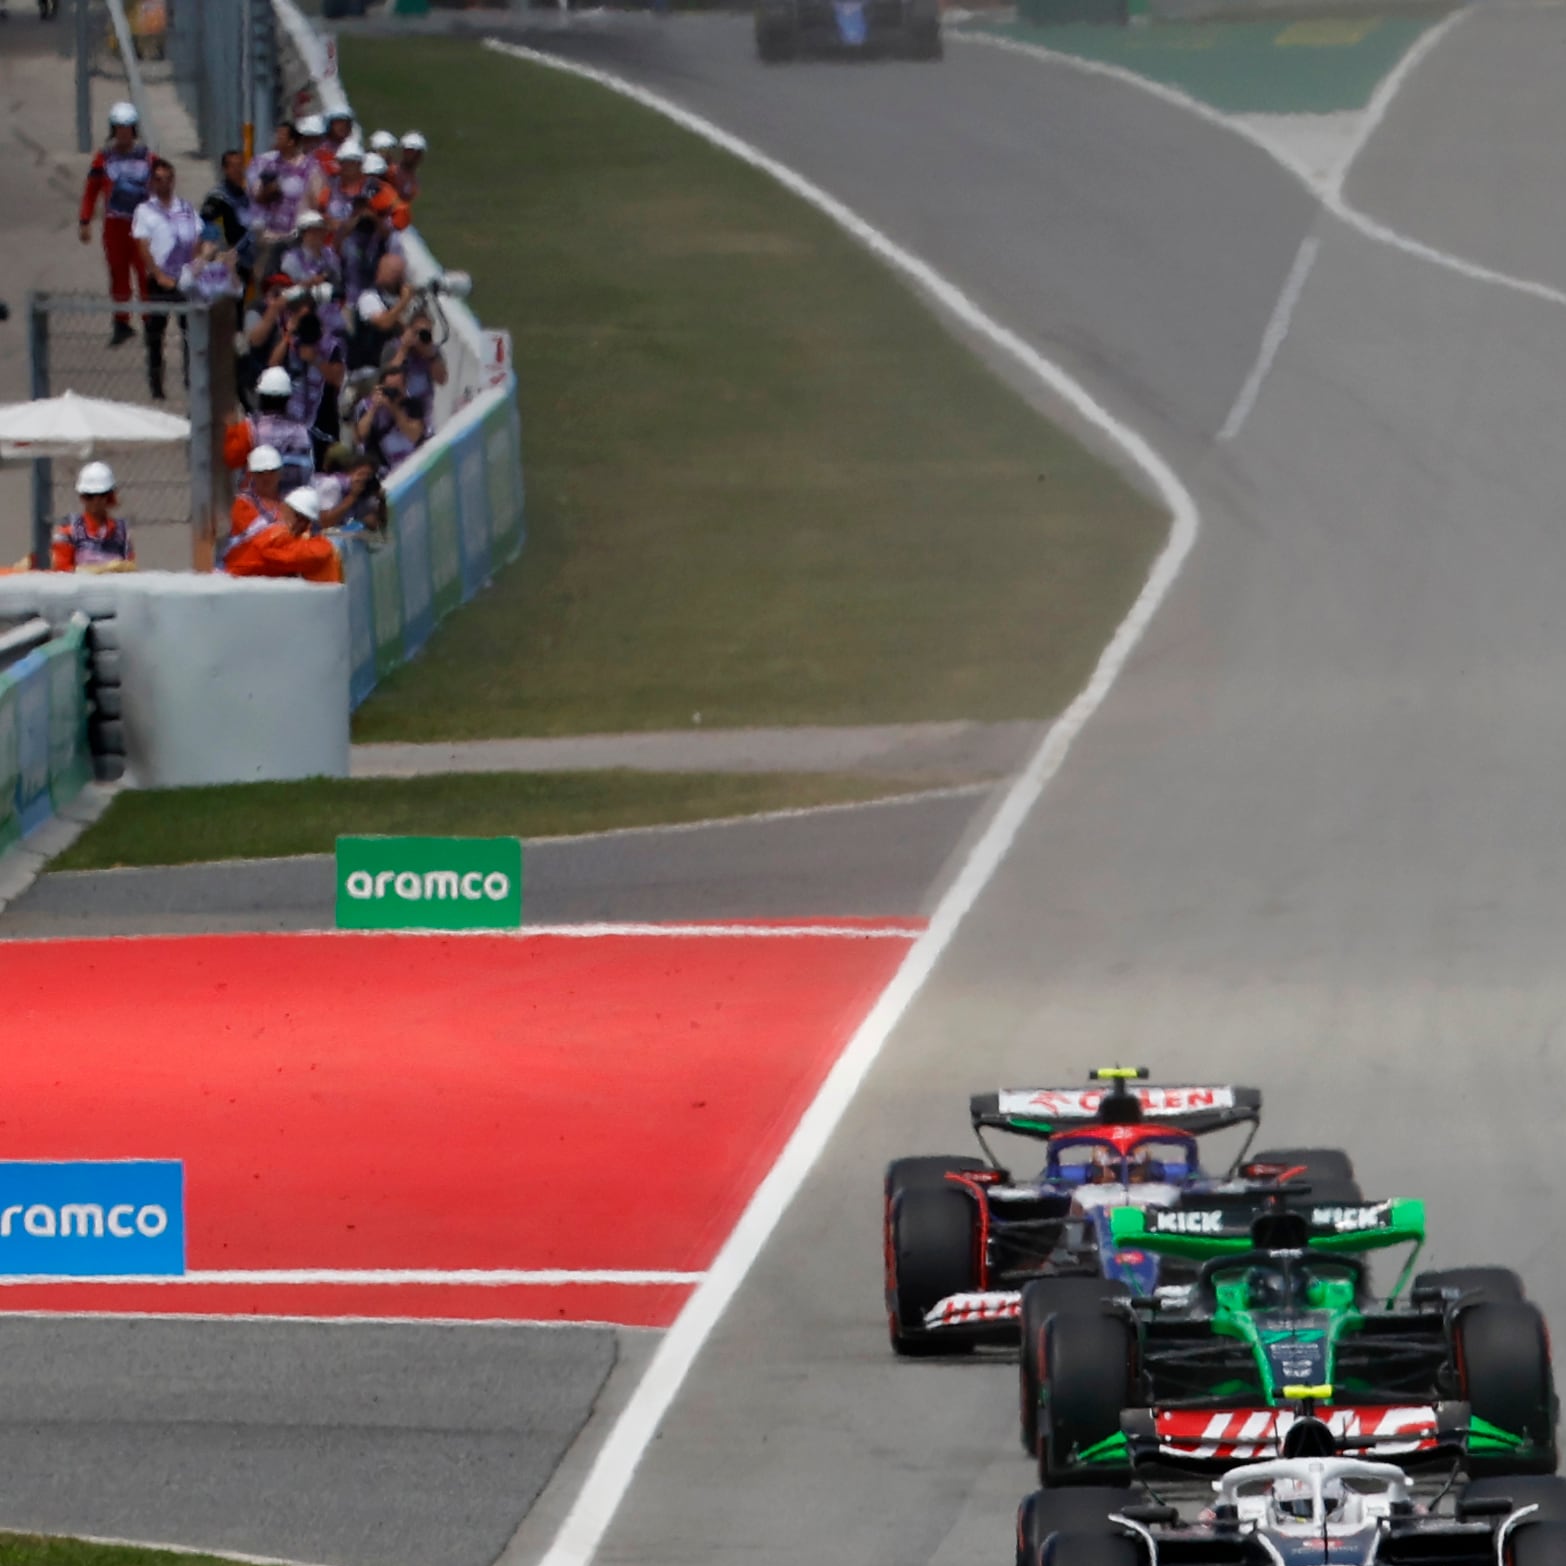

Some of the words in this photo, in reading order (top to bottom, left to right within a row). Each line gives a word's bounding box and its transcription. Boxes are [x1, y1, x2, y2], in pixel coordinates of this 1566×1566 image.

[346, 869, 510, 900] aramco
[1078, 1088, 1215, 1110] OLEN
[0, 1203, 168, 1238] ramco
[1156, 1209, 1224, 1233] KICK
